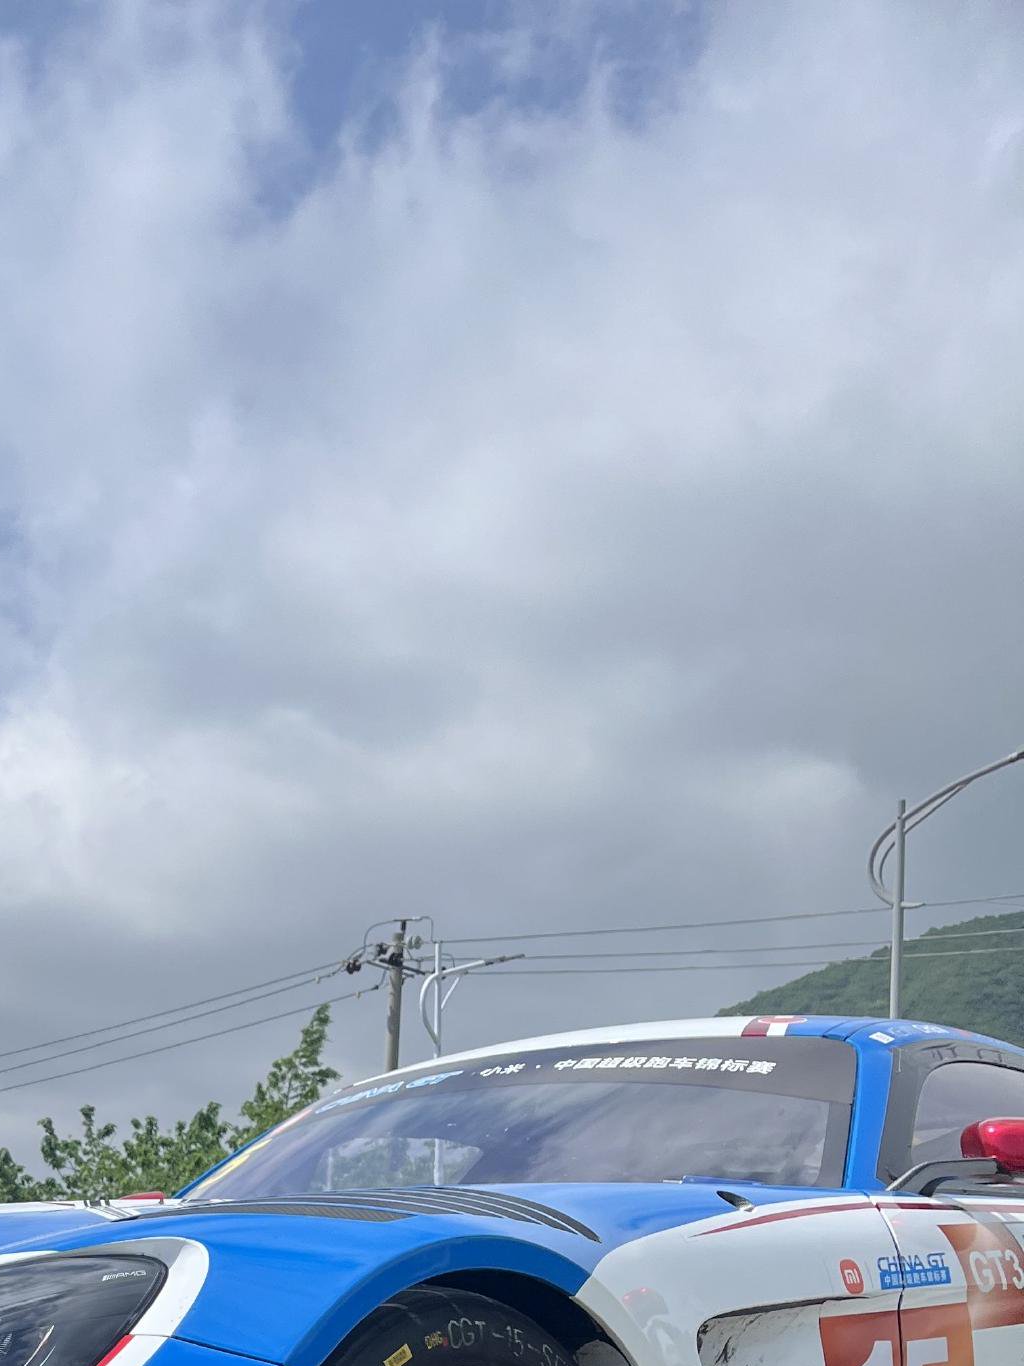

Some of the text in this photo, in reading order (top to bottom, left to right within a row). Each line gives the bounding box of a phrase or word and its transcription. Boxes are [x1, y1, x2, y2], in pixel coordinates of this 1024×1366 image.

[554, 1057, 776, 1075] 中国超级跑车锦标赛
[969, 1249, 1024, 1293] GT3
